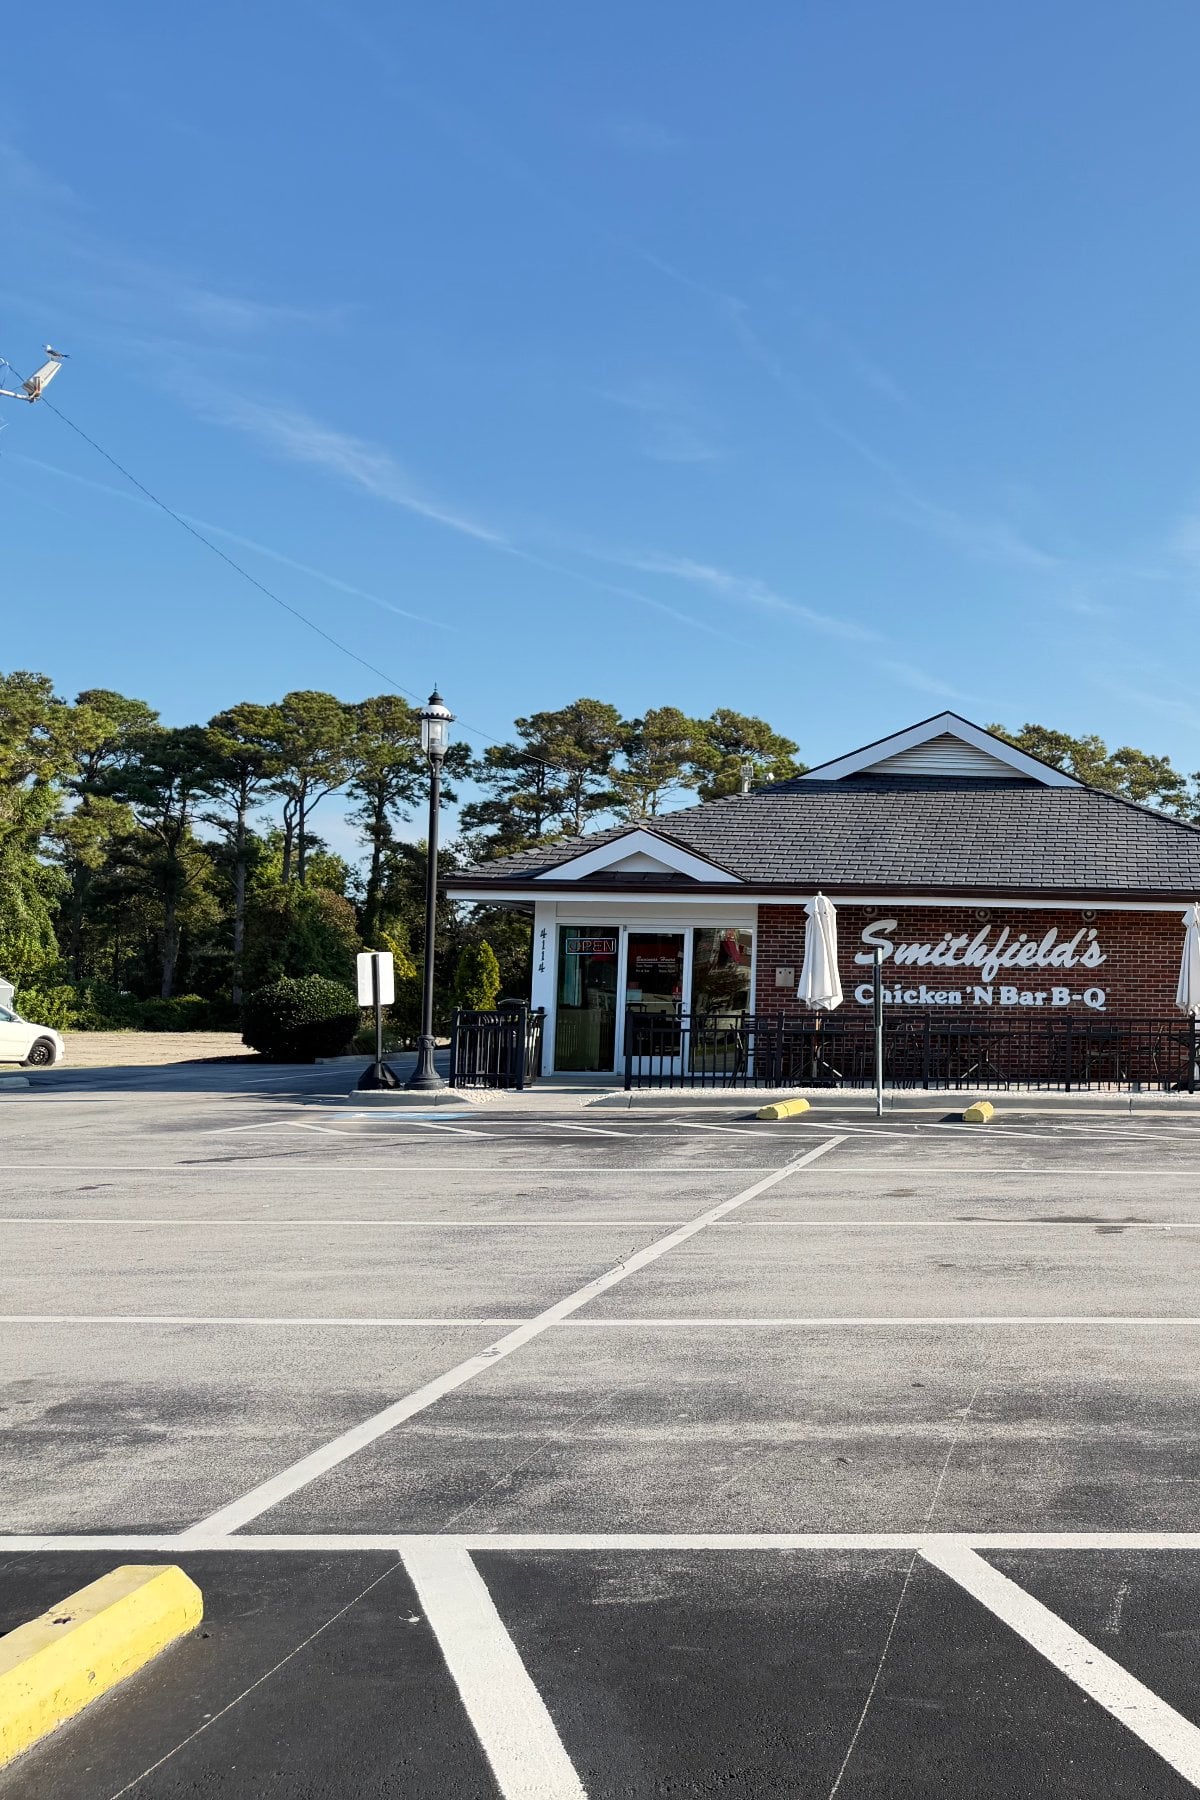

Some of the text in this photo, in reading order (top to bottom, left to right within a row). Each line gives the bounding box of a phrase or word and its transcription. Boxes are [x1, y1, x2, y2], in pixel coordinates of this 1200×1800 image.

[538, 927, 548, 973] 4114
[569, 940, 614, 952] OPEN
[854, 919, 1107, 982] Smithfield's
[854, 984, 962, 1005] Chicken
[1000, 986, 1047, 1006] Bar
[1051, 987, 1106, 1010] B-Q
